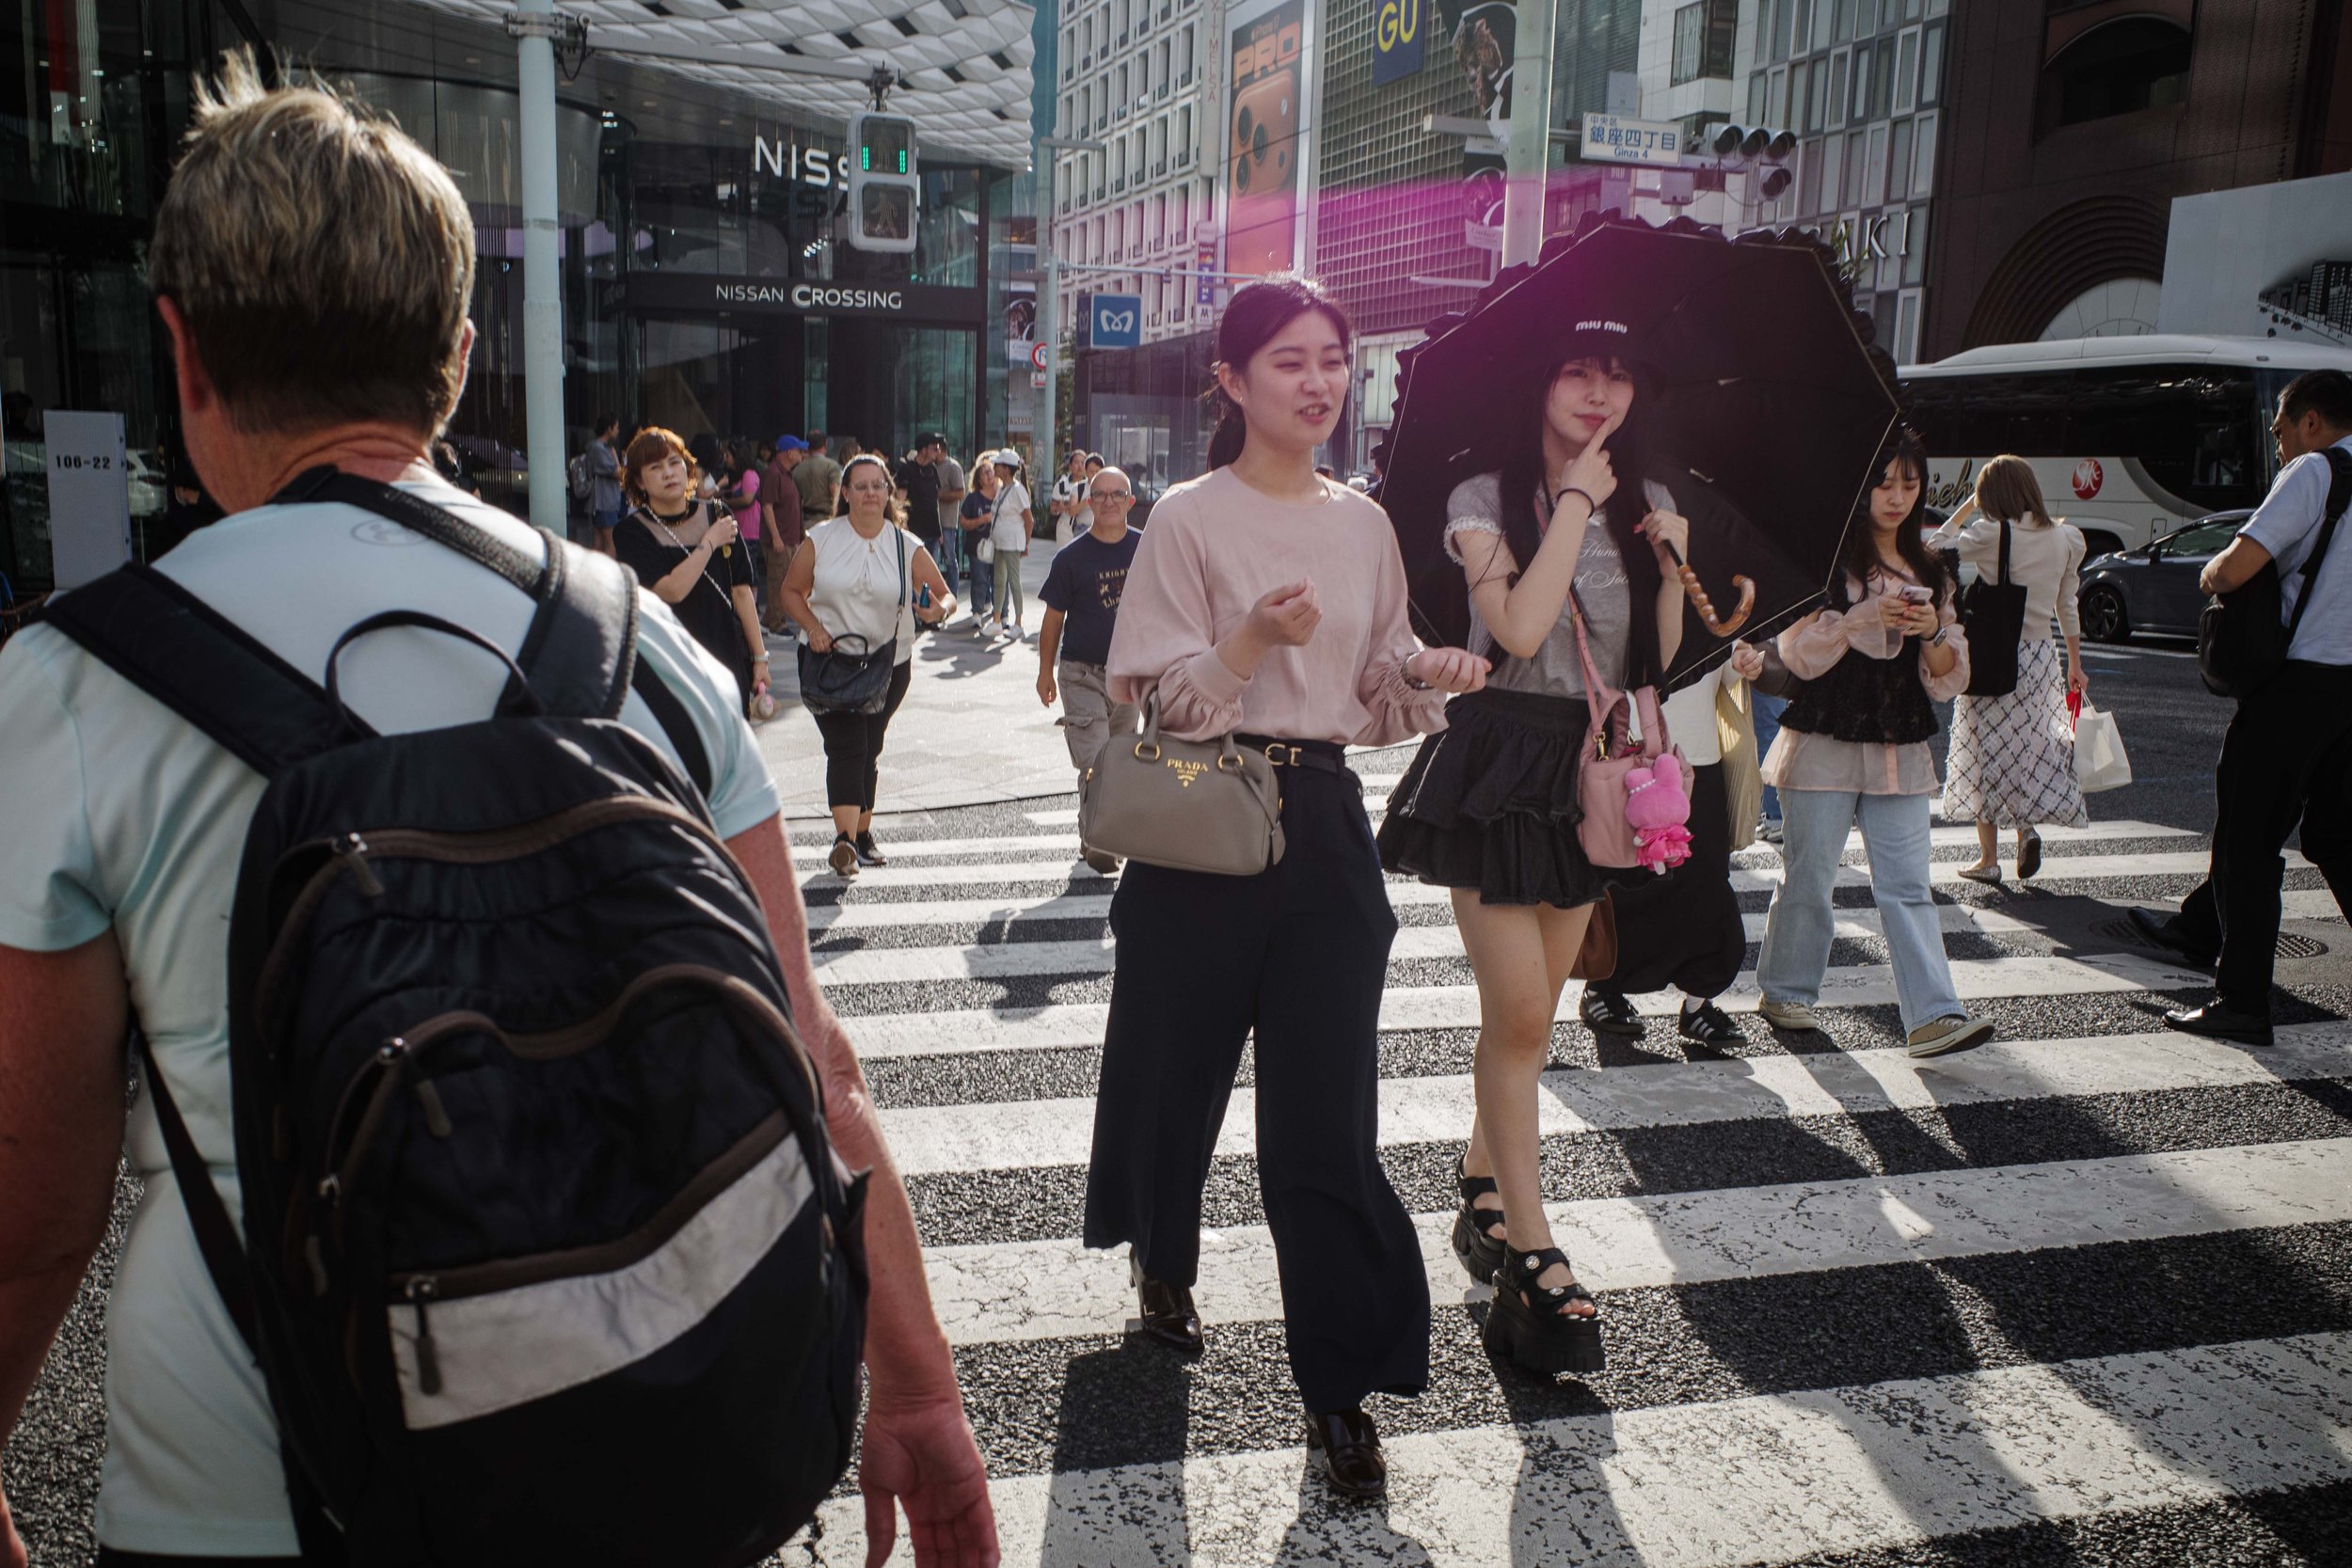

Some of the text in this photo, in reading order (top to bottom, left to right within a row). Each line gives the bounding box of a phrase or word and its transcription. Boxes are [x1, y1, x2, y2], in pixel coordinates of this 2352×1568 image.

[1377, 0, 1418, 53] GU
[1232, 21, 1301, 90] PRO
[1590, 116, 1617, 126] 中央区
[1590, 126, 1676, 150] 銀座四丁目
[1614, 146, 1648, 159] Ginza 4
[1806, 212, 1913, 265] AKI
[716, 283, 902, 309] NISSAN CROSSING
[56, 455, 111, 468] 106-22
[1167, 758, 1208, 772] PRADA
